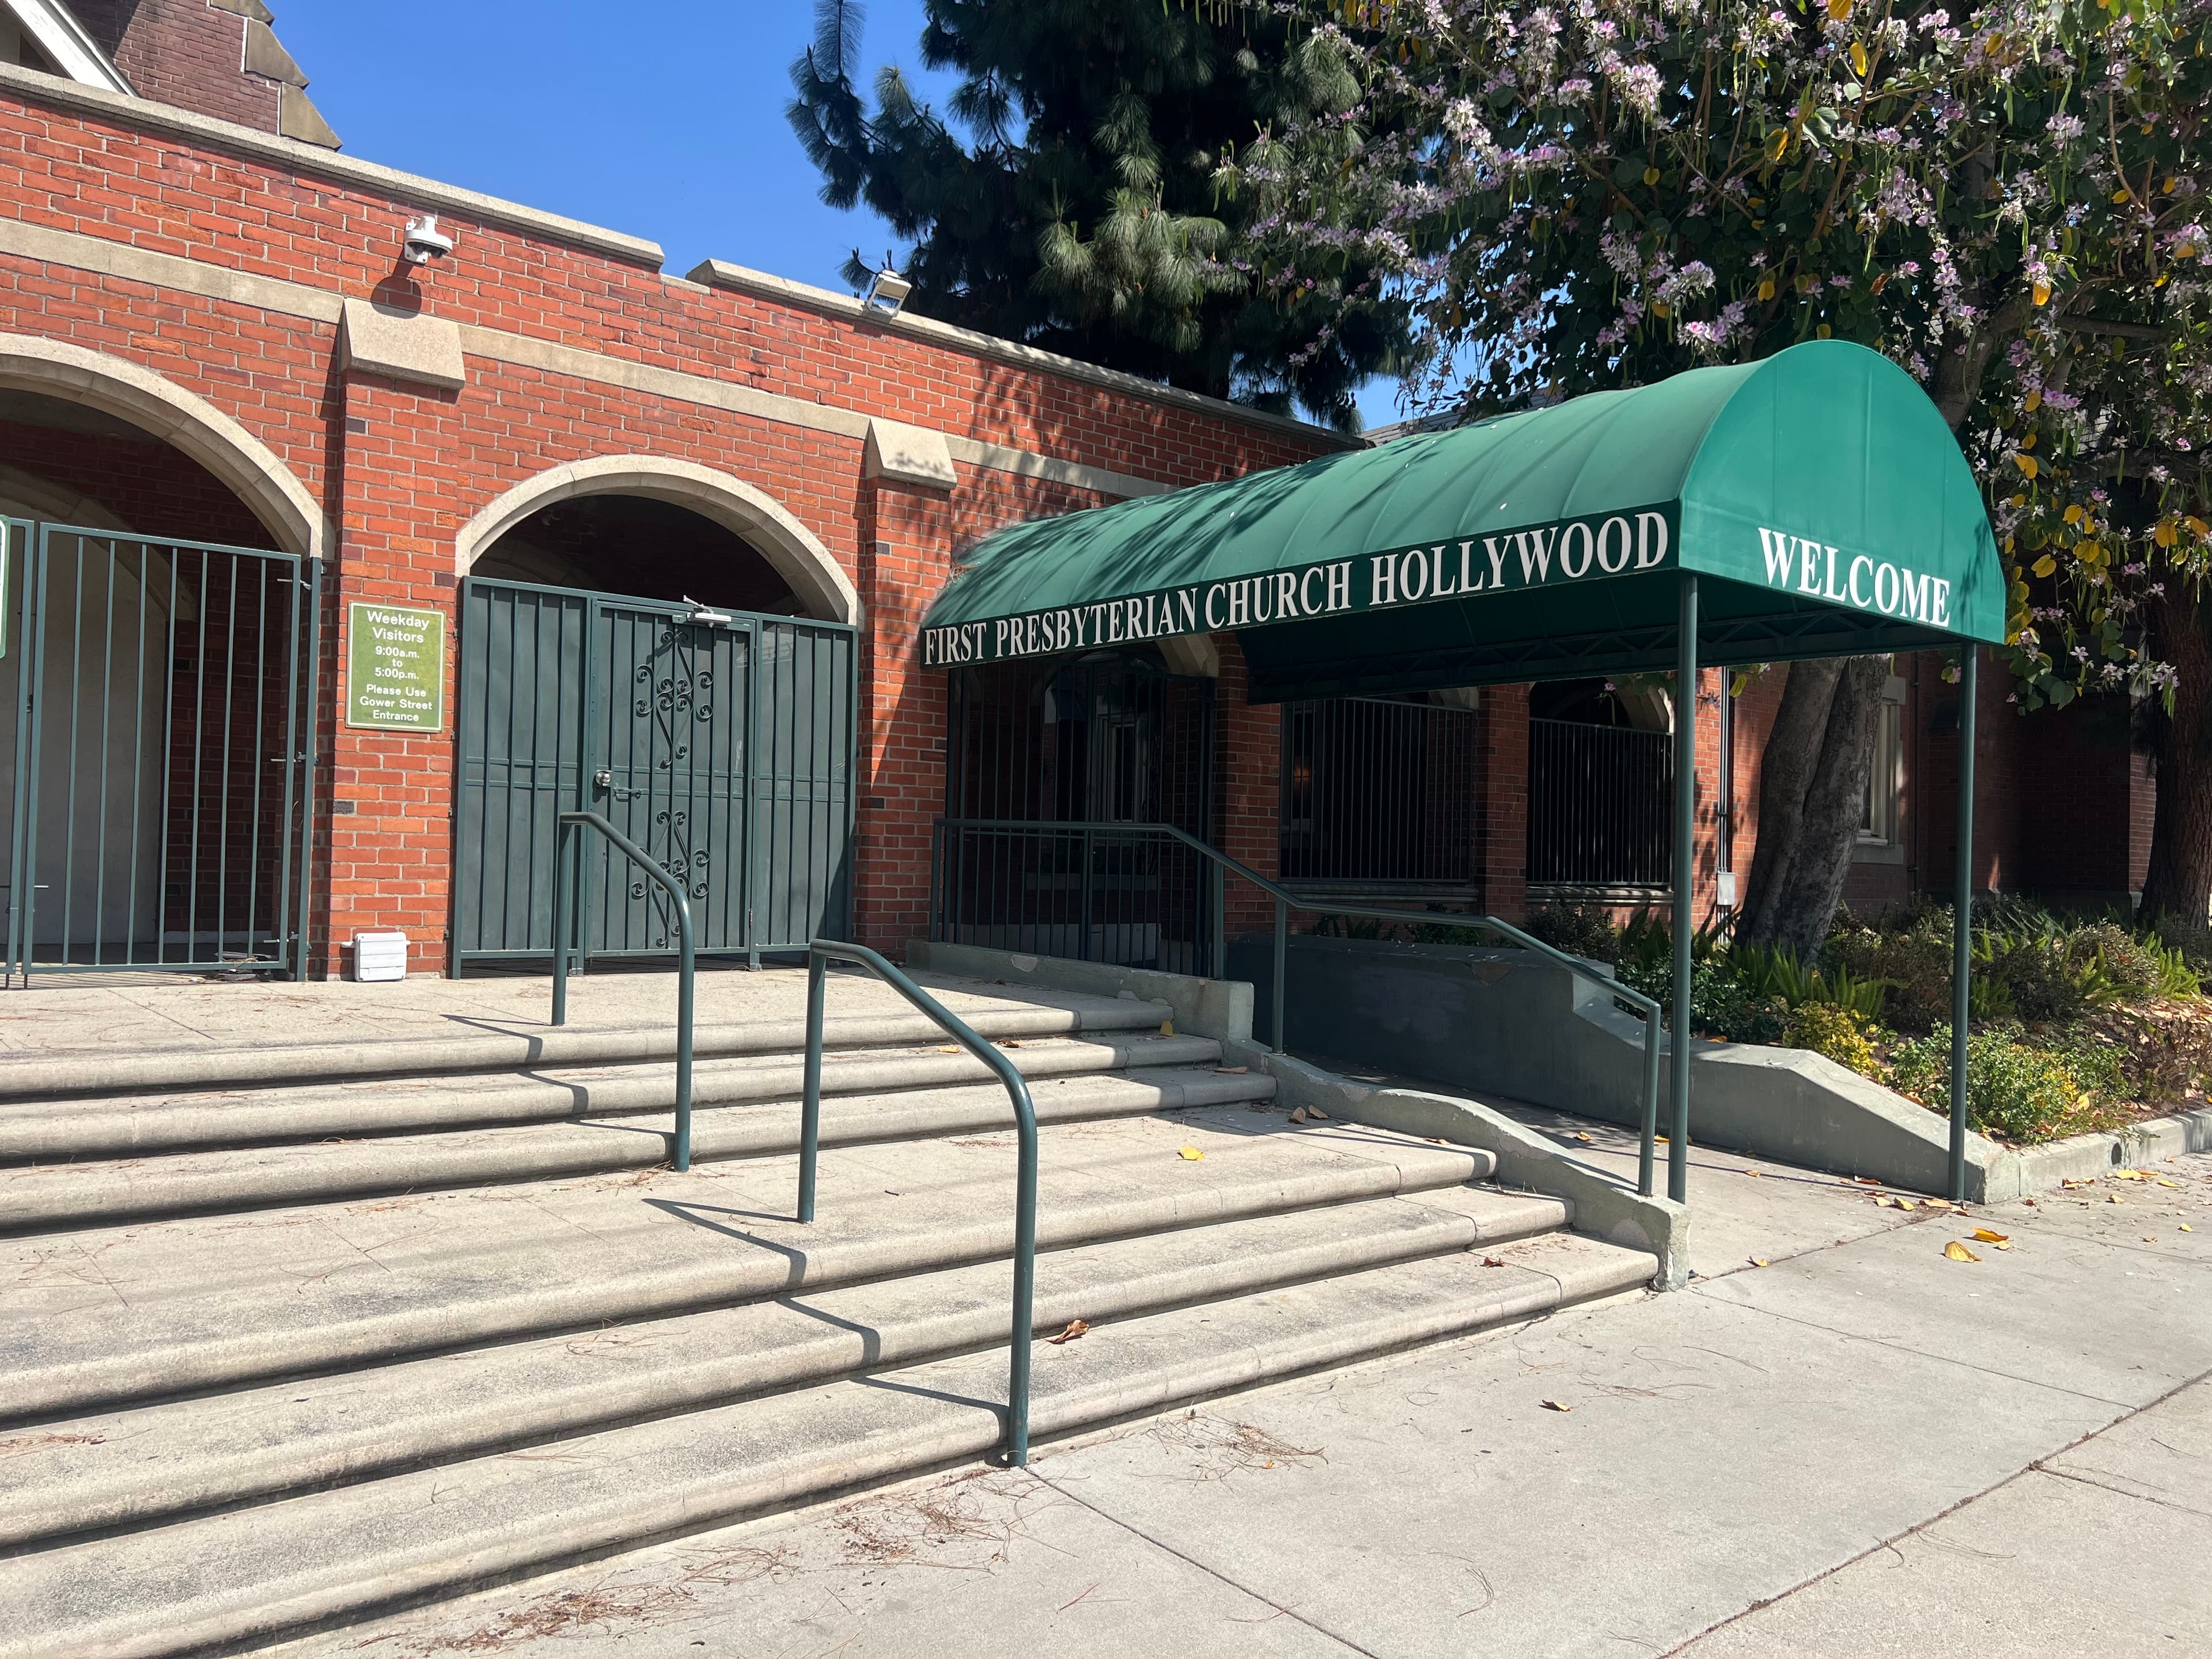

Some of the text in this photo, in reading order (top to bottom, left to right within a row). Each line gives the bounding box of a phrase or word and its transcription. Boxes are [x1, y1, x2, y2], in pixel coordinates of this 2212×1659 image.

[1758, 527, 1950, 627] WELCOME
[924, 512, 1668, 665] FIRST PRESBYTERIAN CHURCH HOLLYWOOD
[366, 610, 429, 631] Weekday
[372, 626, 424, 643] Visitors
[375, 646, 419, 658] 9:00a.m.
[392, 658, 403, 667] to
[374, 667, 419, 679] 5:00p.m.
[366, 684, 426, 696] Please Use
[359, 696, 432, 710] Gower Street
[373, 710, 418, 721] Entrance
